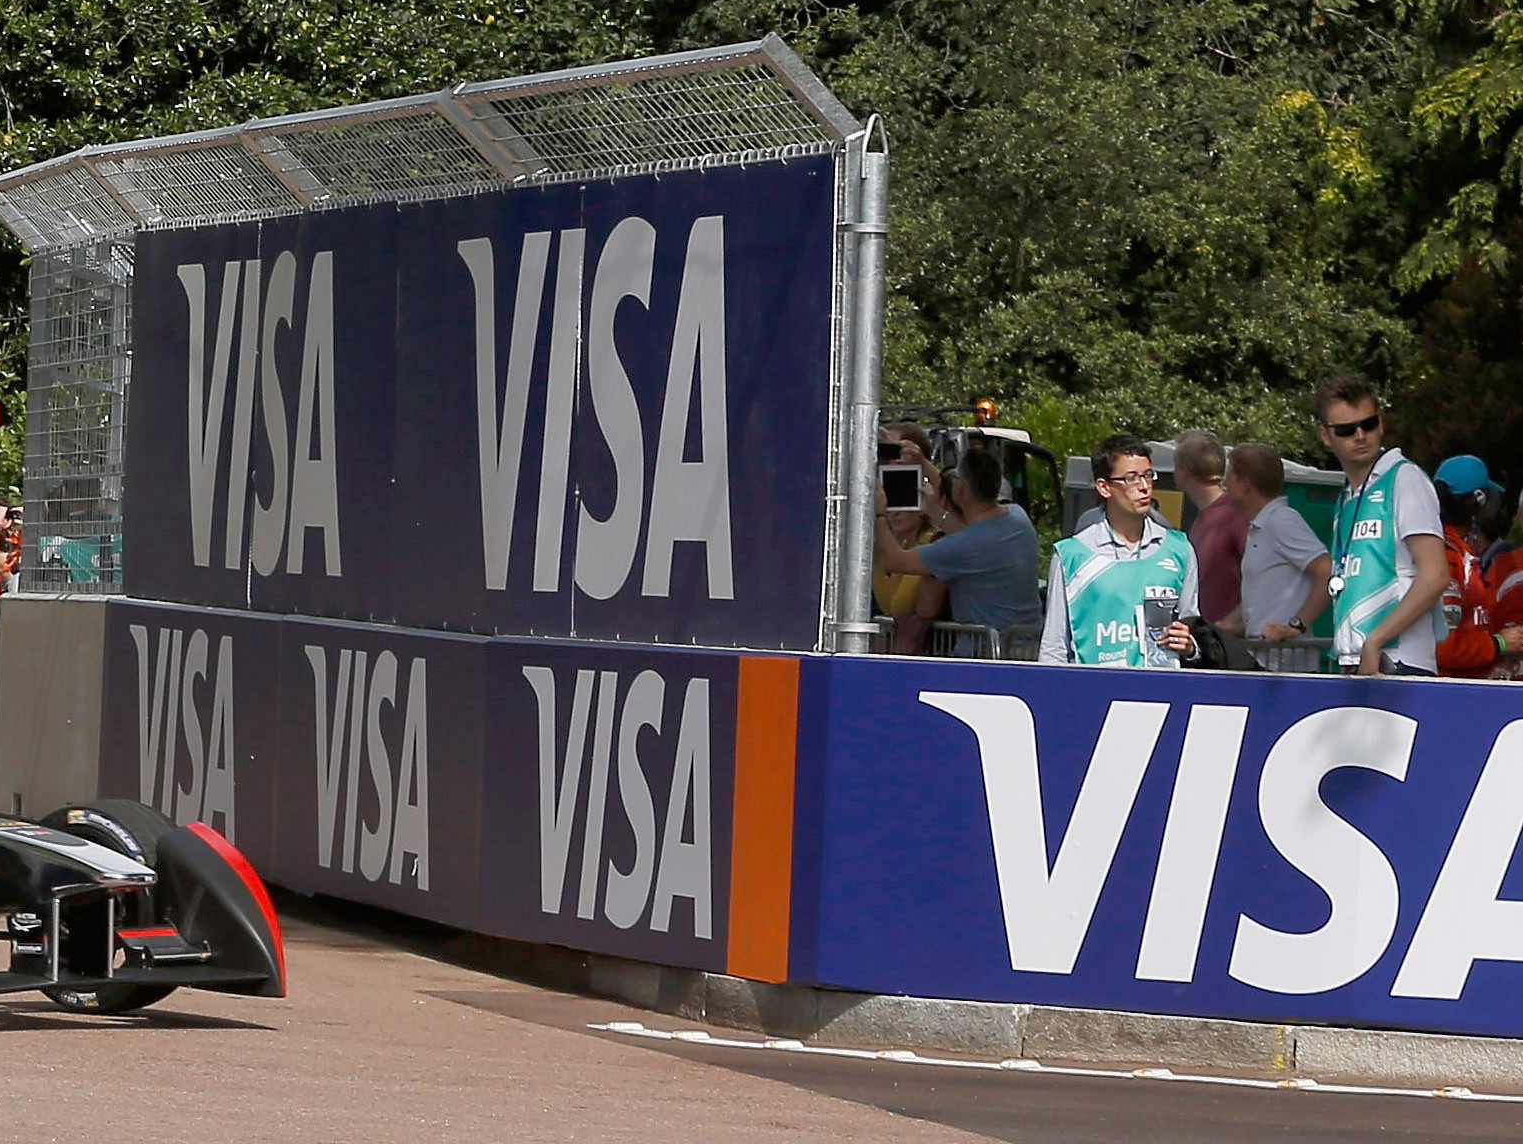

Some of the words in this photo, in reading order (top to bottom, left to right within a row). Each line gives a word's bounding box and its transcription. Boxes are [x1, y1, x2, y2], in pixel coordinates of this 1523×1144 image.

[177, 250, 342, 578] VISA
[458, 215, 735, 600] VISA
[1356, 521, 1379, 537] 104
[129, 624, 236, 846] VISA
[305, 644, 430, 892] VISA
[1098, 648, 1128, 662] Round
[522, 666, 713, 940] VISA
